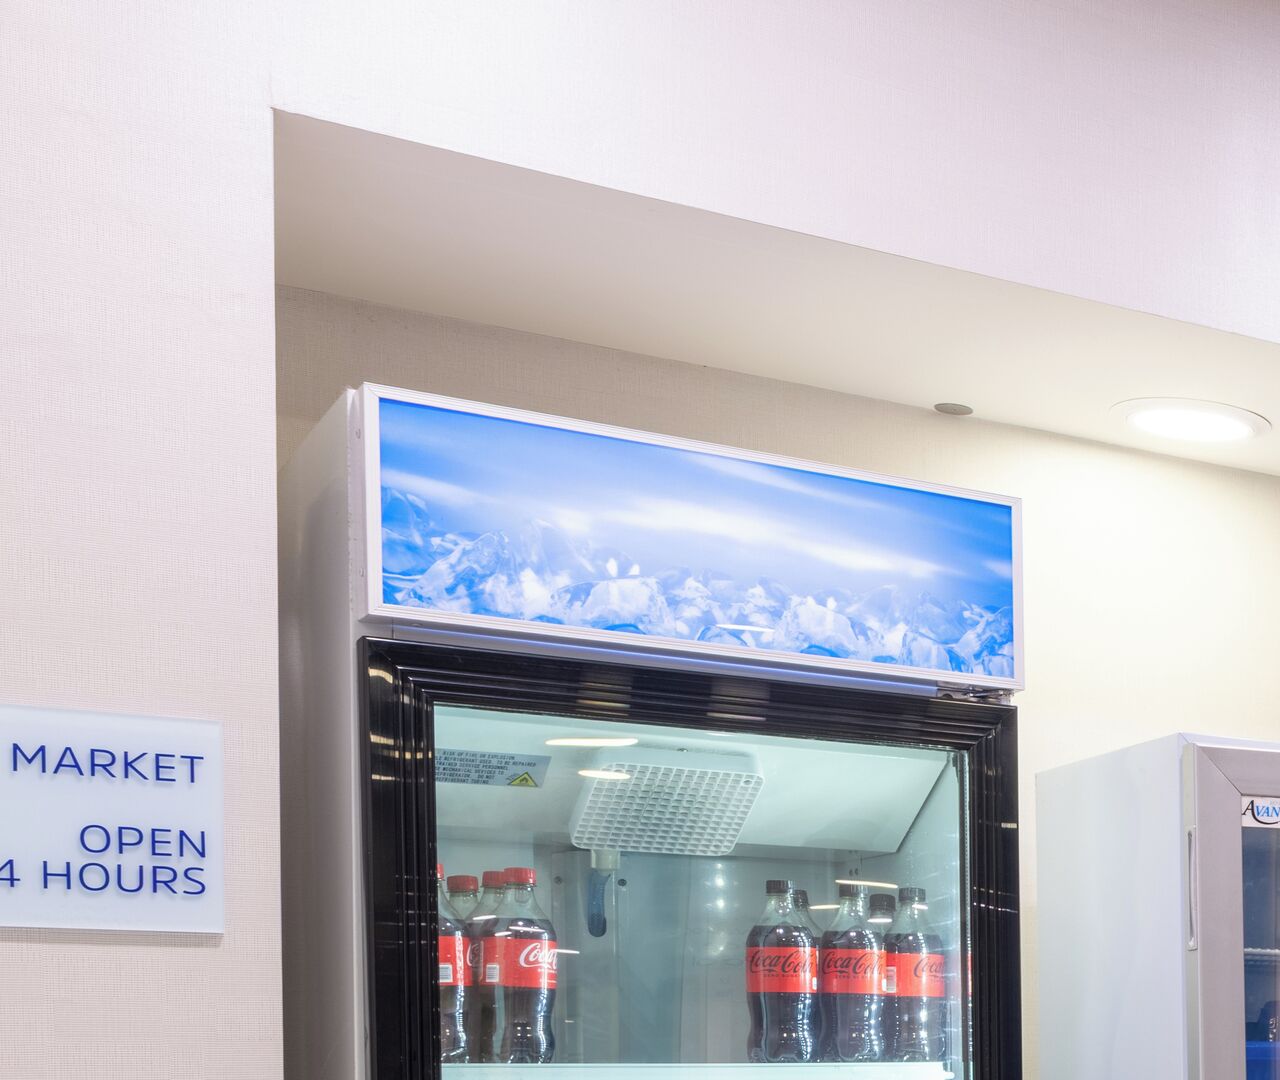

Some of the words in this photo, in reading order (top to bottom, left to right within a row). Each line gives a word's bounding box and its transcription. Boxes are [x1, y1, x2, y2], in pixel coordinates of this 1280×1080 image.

[12, 742, 204, 783] MARKET
[79, 824, 206, 858] OPEN
[42, 860, 206, 895] HOURS
